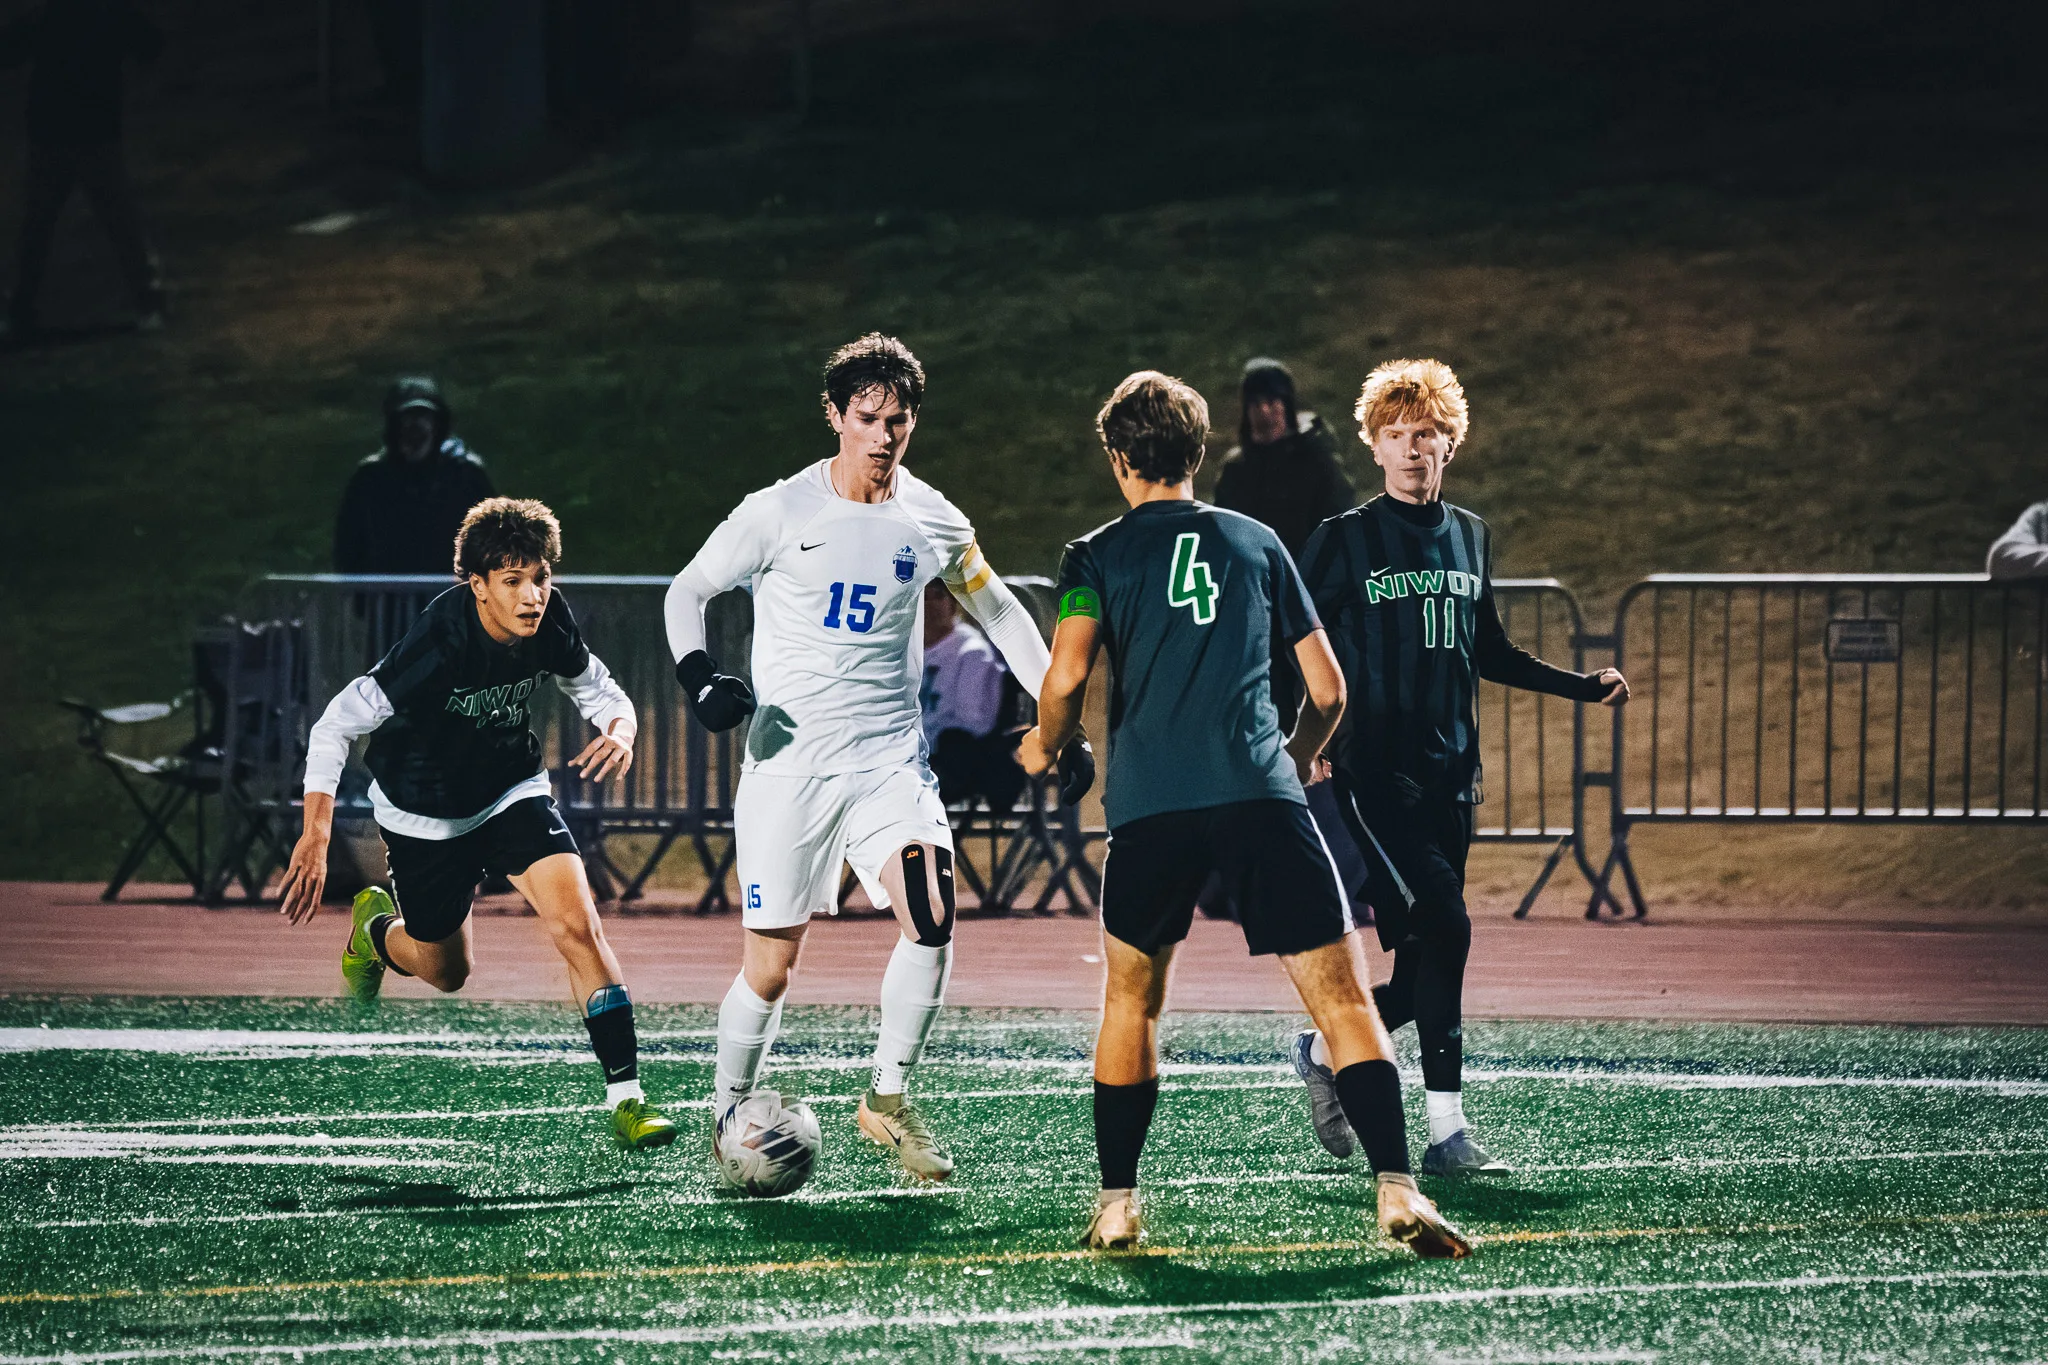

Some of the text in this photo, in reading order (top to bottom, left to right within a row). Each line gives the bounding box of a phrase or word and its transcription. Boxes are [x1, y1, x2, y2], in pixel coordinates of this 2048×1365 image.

[1168, 532, 1219, 625] 4
[823, 581, 877, 633] 15
[1423, 597, 1454, 648] 11
[747, 883, 762, 909] 15
